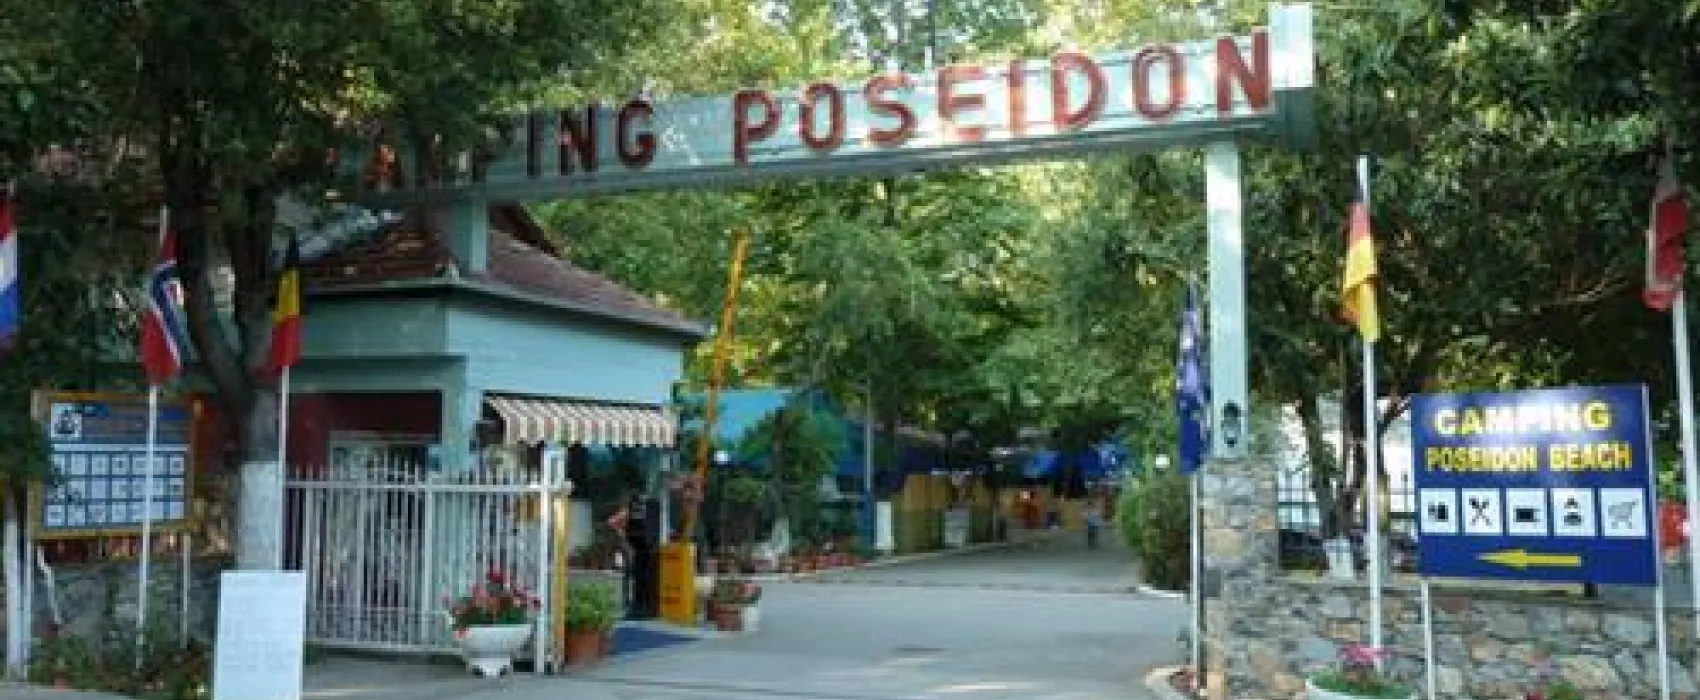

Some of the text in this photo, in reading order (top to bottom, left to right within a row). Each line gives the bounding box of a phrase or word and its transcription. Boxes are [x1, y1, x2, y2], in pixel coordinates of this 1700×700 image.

[732, 28, 1272, 164] POSEIDON
[1434, 402, 1612, 435] CAMPING
[1425, 441, 1633, 472] POSEIDON BEACH
